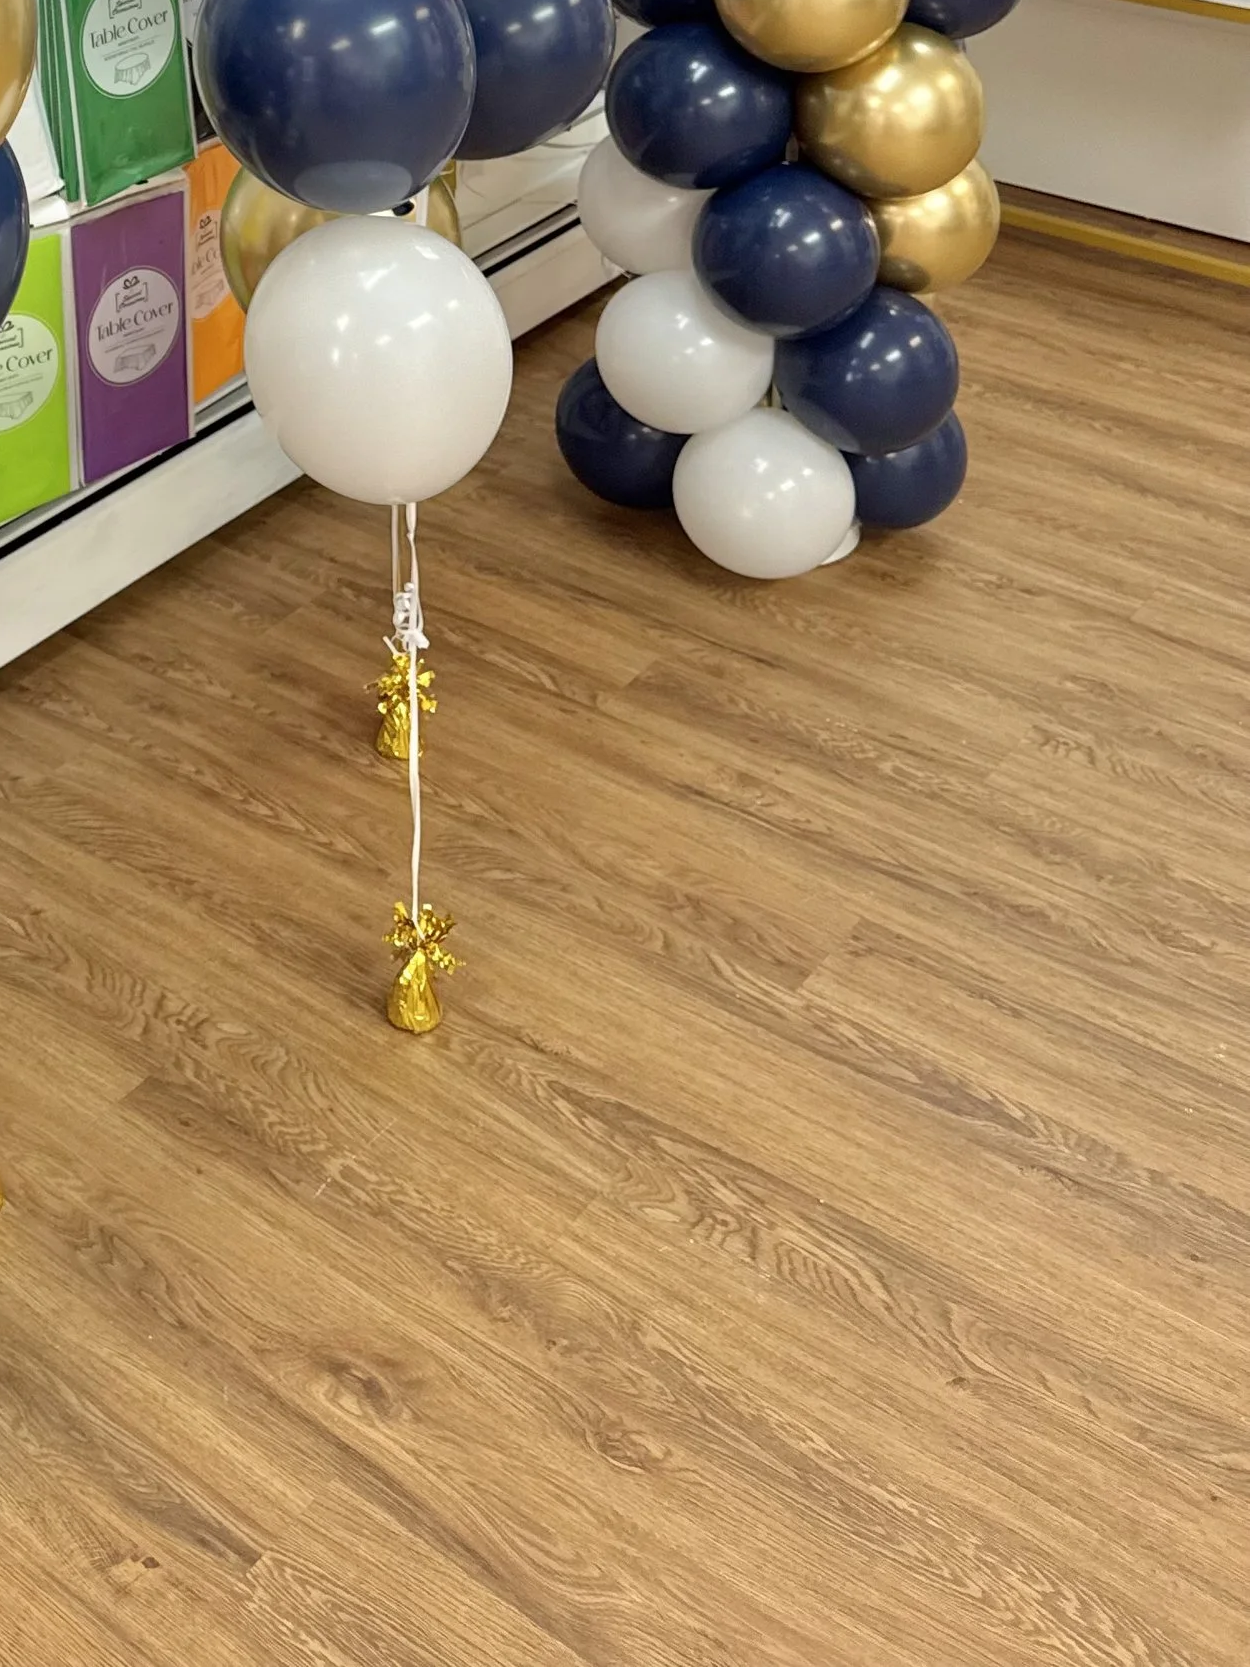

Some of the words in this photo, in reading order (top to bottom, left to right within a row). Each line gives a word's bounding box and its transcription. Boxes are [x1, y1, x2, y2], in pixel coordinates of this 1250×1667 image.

[91, 24, 126, 49] Table
[127, 10, 168, 34] Cover
[95, 317, 132, 342] Table
[133, 301, 174, 326] Cover
[5, 348, 53, 372] Cover
